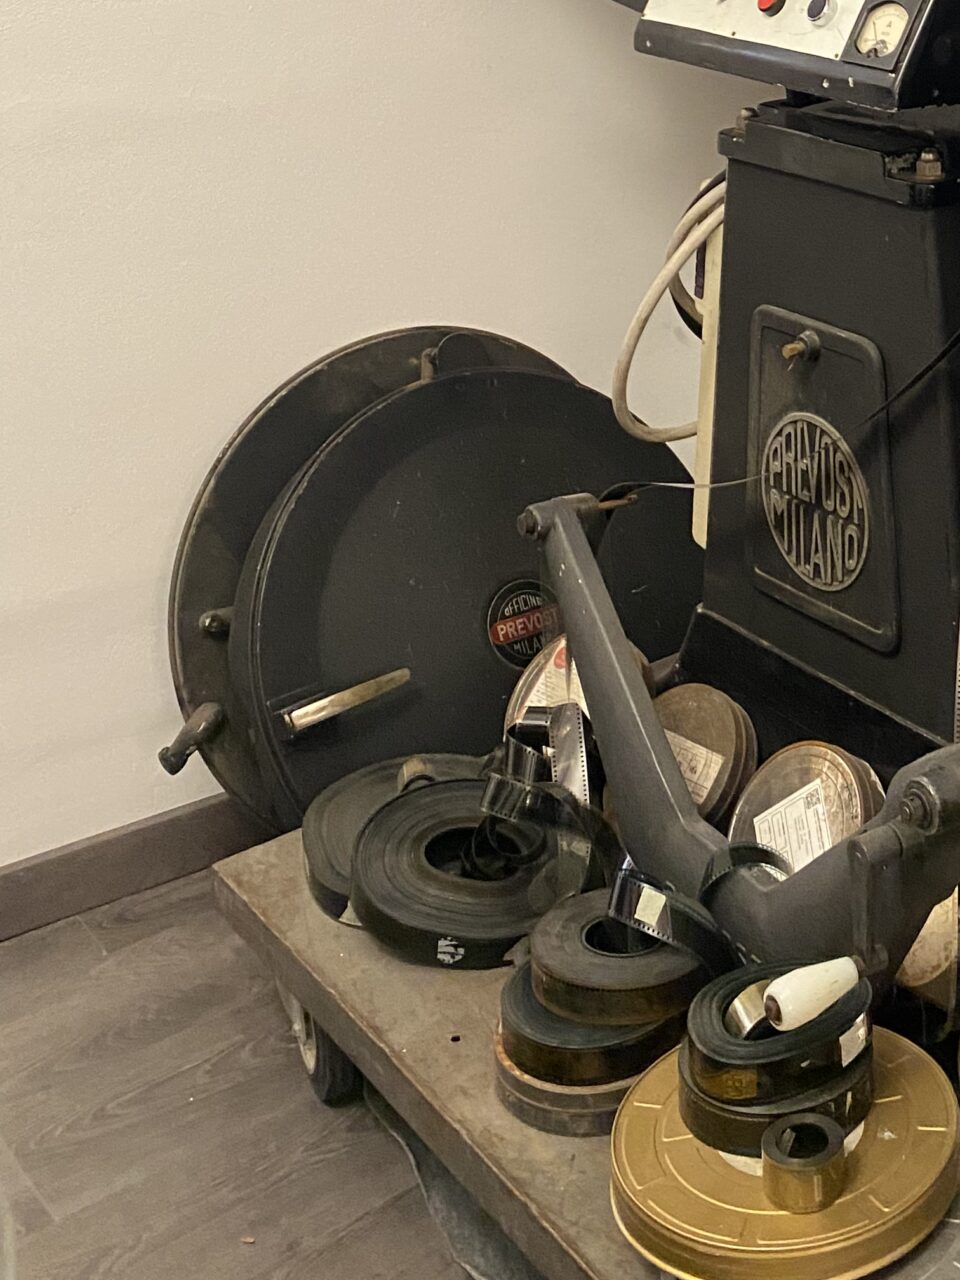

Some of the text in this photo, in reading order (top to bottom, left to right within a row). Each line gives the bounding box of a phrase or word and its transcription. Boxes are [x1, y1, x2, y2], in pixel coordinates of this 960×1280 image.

[769, 488, 860, 586] MILANO
[504, 594, 543, 617] OFFICINE
[496, 609, 559, 642] PREVOST
